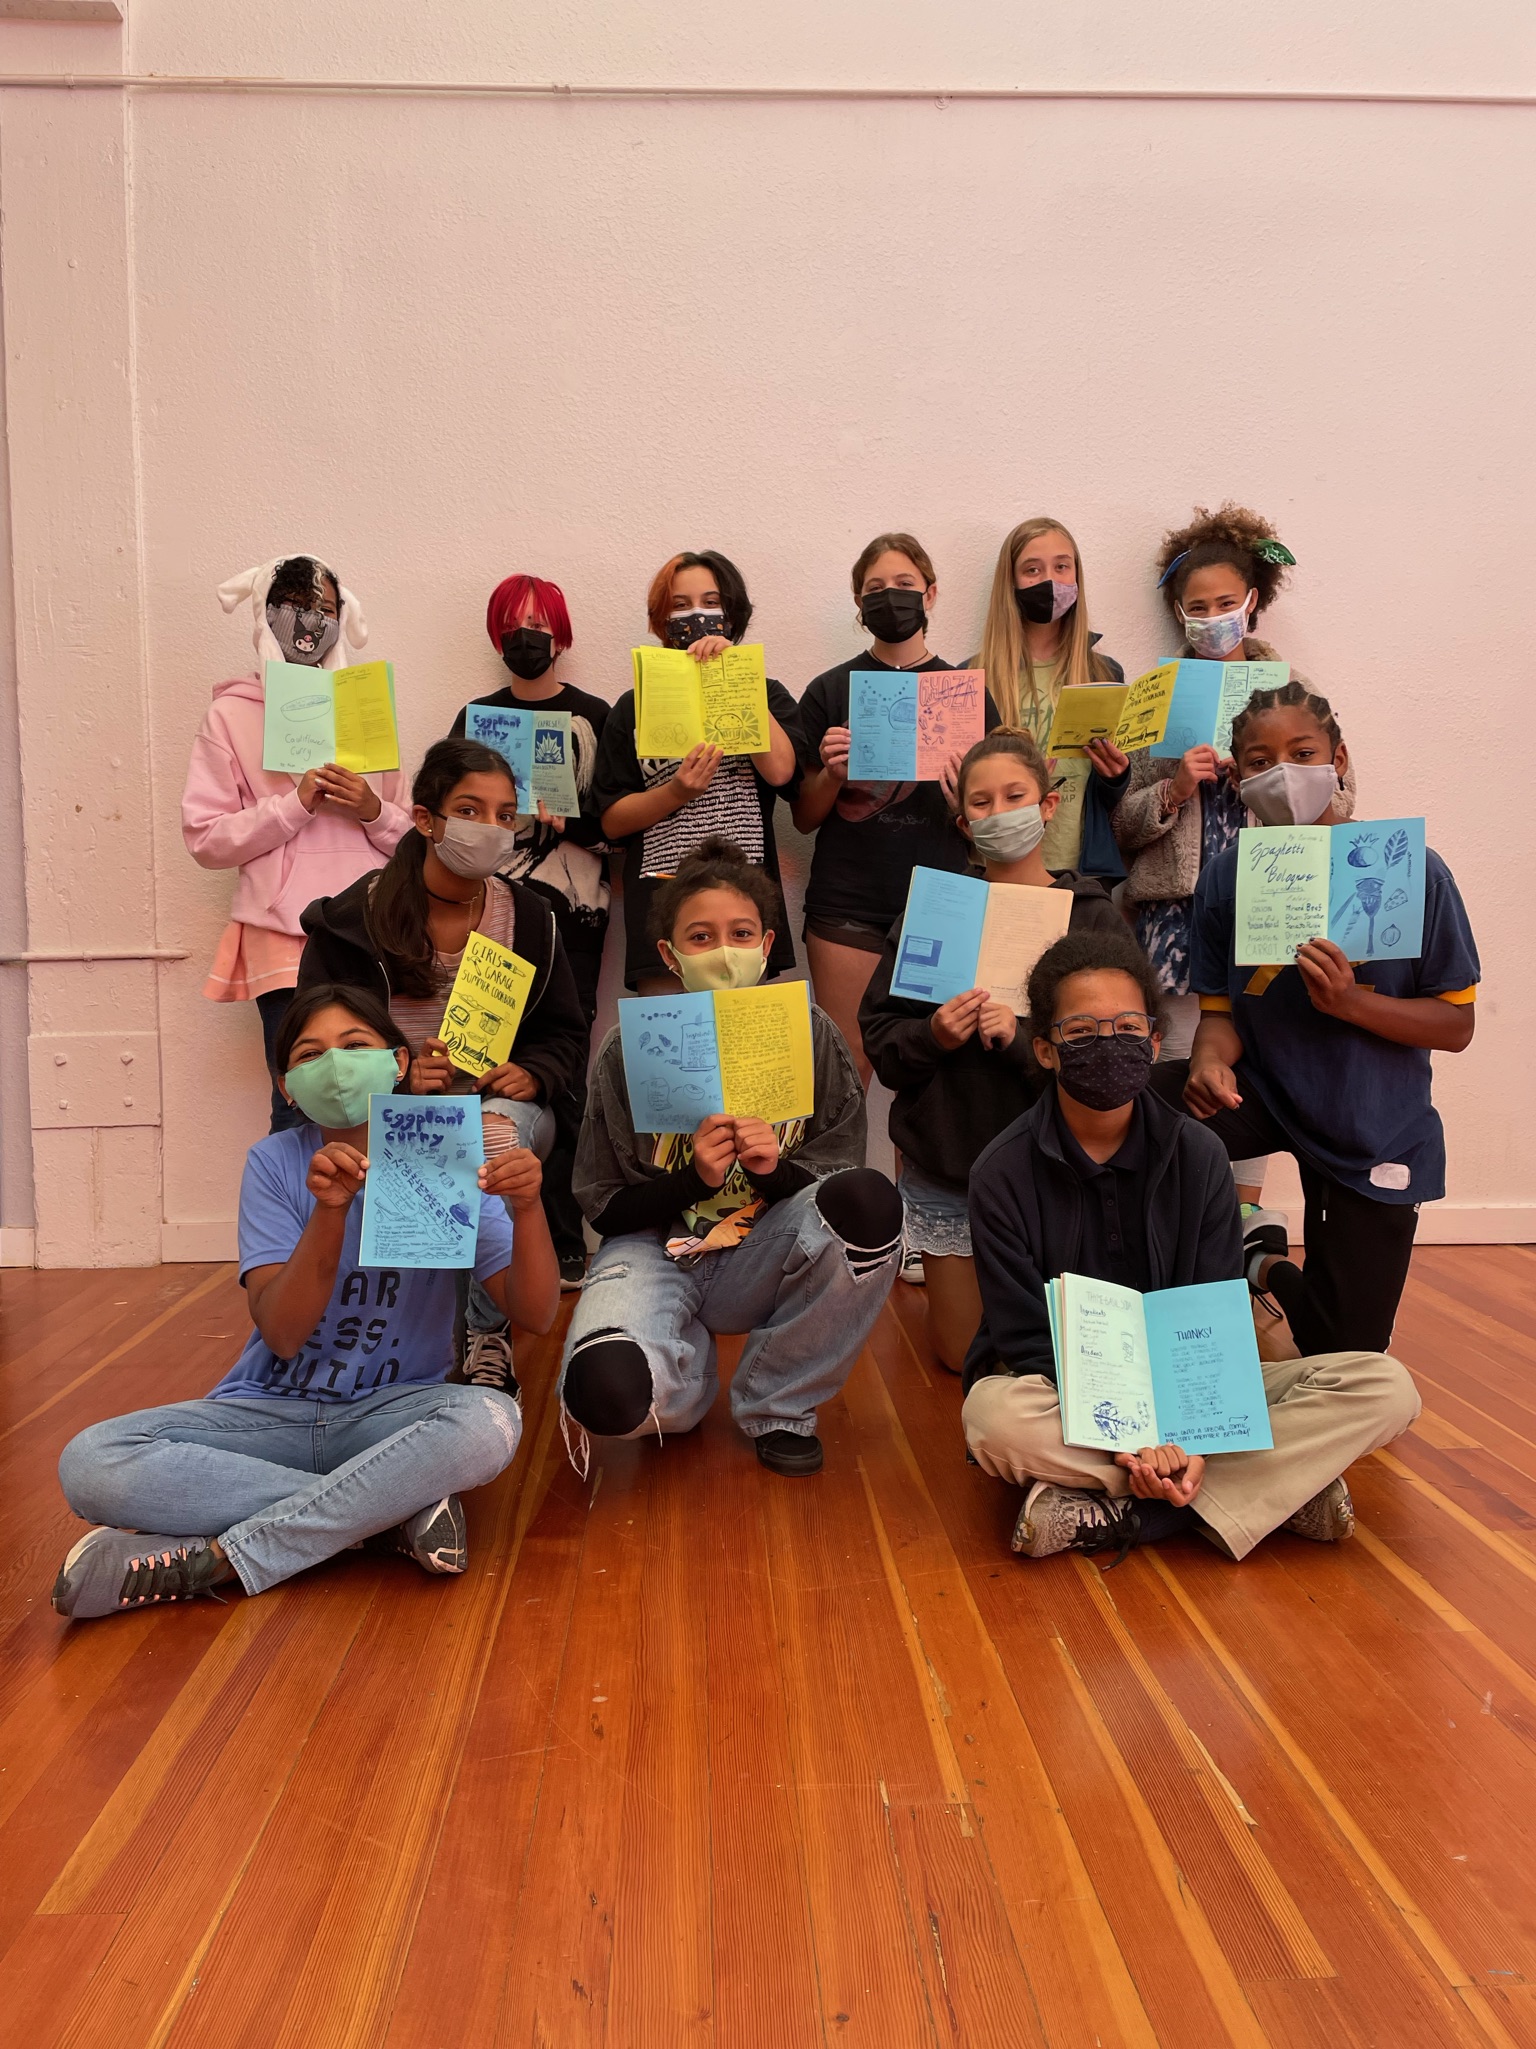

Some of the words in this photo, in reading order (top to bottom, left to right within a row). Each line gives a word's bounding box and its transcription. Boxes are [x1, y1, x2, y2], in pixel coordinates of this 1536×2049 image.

[919, 675, 977, 707] GYOZA
[473, 714, 521, 730] Eggplant
[285, 733, 326, 746] Cauliflower
[290, 745, 312, 762] Curry
[1250, 842, 1306, 873] Spaghetti
[471, 941, 503, 968] GIRLS
[1245, 944, 1278, 956] CARROT
[461, 969, 490, 994] SUMMER
[491, 986, 516, 1010] COOKBOOK
[484, 966, 514, 992] GARAGE
[382, 1107, 465, 1131] Eggplant
[341, 1270, 401, 1308] AR
[307, 1316, 400, 1355] ESS.
[1174, 1326, 1212, 1342] THANKS!
[1193, 1432, 1220, 1440] MEMBER
